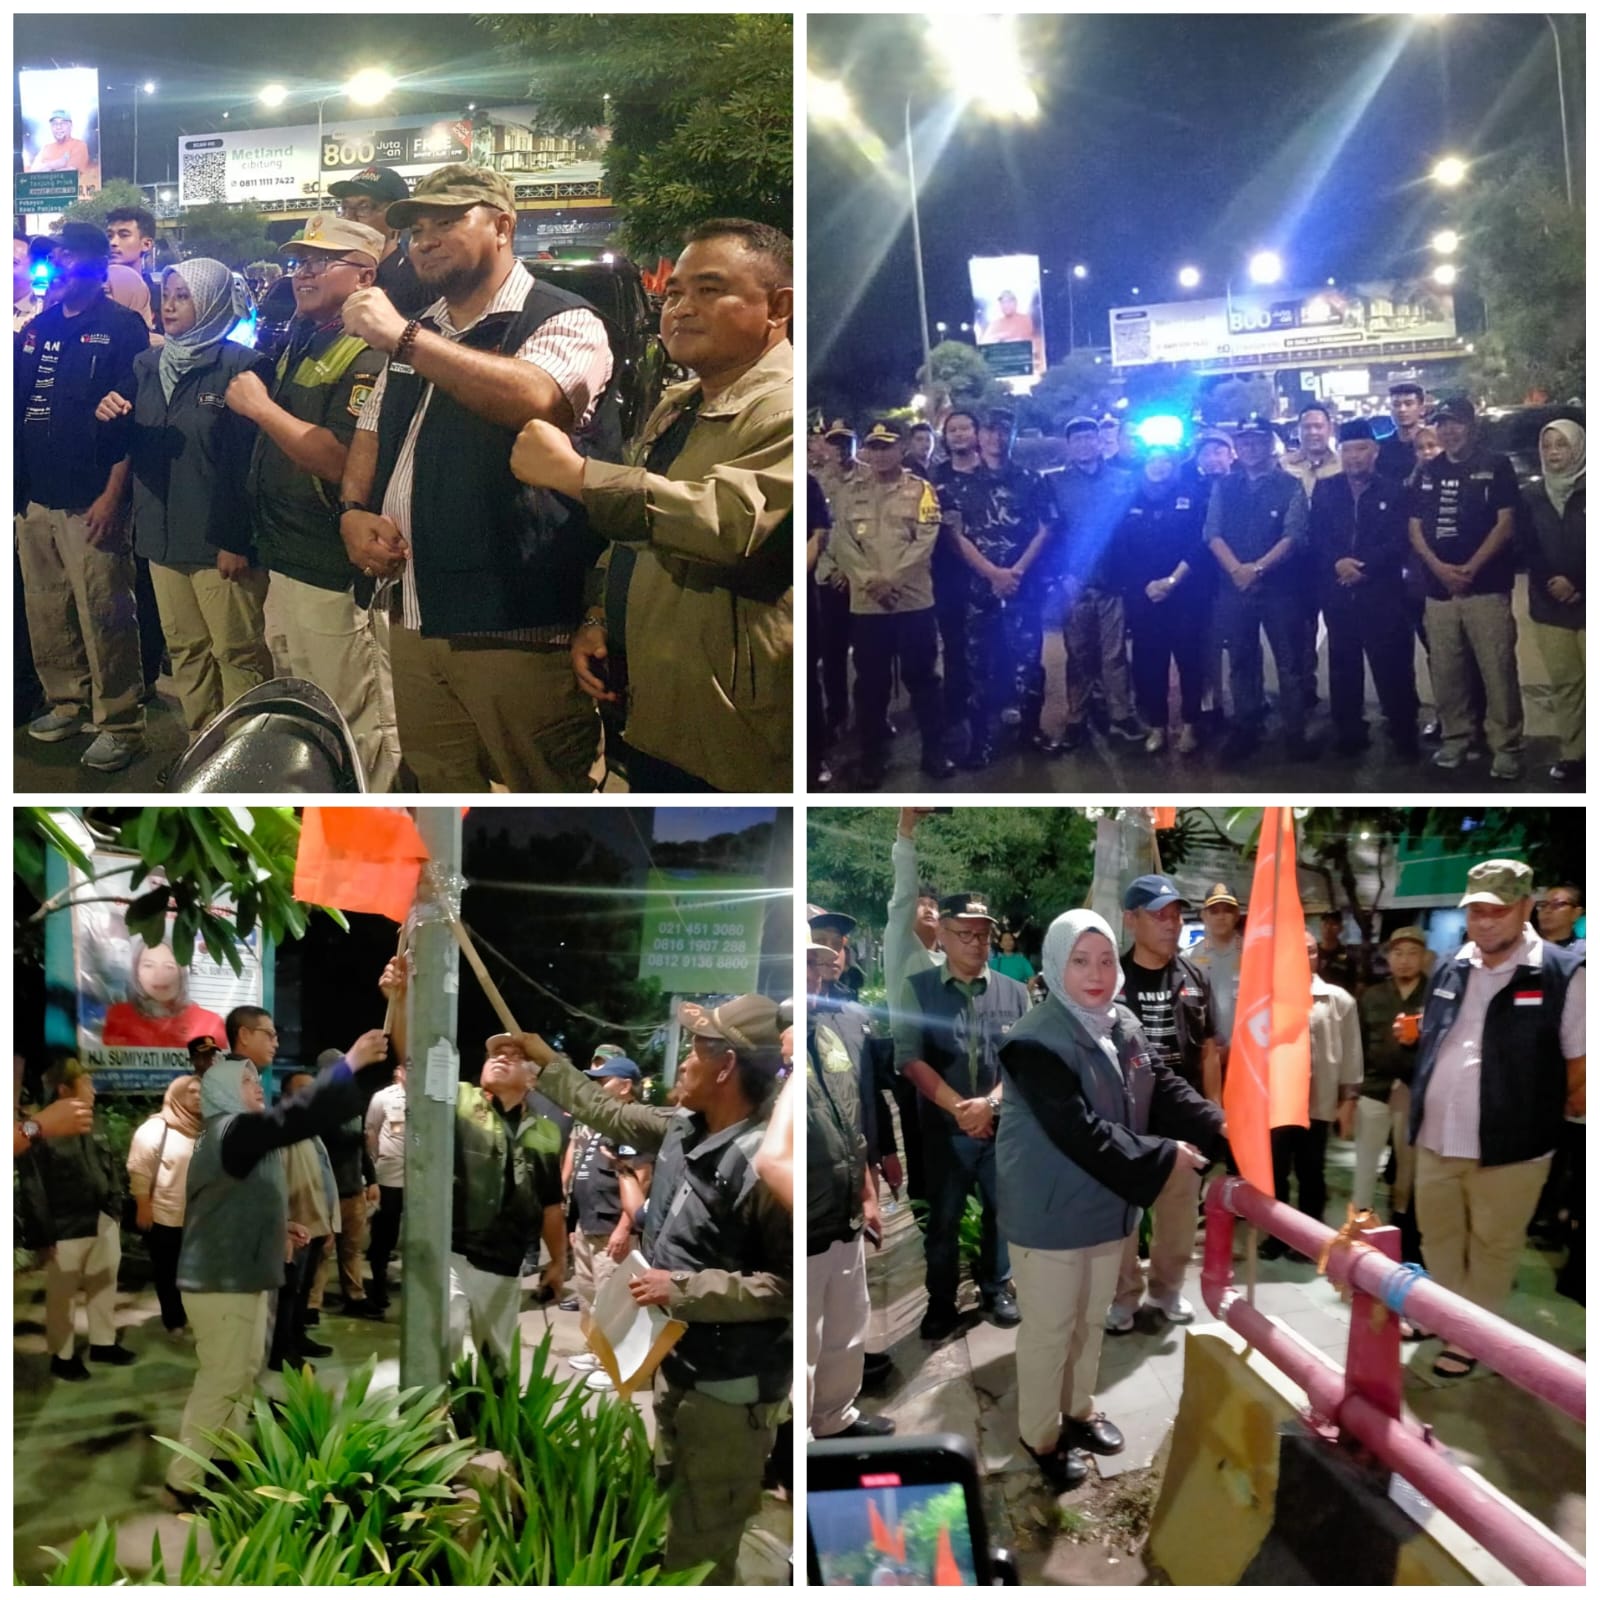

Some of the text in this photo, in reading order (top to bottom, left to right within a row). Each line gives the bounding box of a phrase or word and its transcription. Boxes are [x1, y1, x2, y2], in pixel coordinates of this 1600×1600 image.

[231, 145, 294, 161] Metland
[323, 139, 401, 167] 800 Juta
[241, 160, 282, 170] cibitung
[239, 179, 257, 187] 0811
[275, 176, 295, 185] 7422
[658, 922, 680, 934] 021
[712, 924, 744, 936] 3080
[654, 938, 684, 951] 0816
[690, 939, 718, 952] 1907
[648, 954, 679, 967] 0812
[108, 1051, 159, 1068] SUMIYATI
